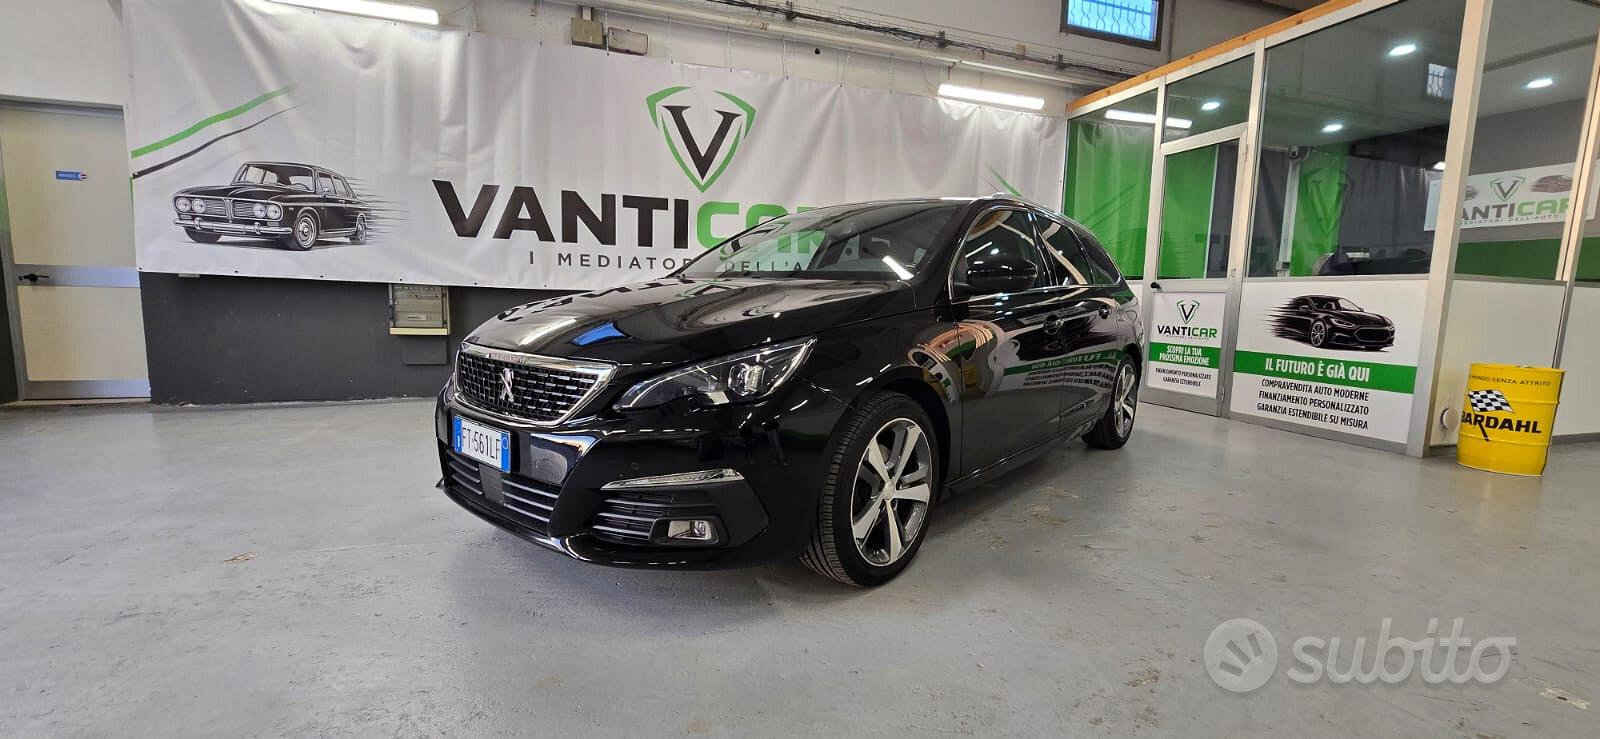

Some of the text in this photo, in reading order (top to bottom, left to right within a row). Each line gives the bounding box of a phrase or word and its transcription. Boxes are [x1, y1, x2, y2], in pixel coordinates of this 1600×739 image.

[662, 105, 743, 183] V
[1462, 197, 1570, 221] NTICA
[529, 250, 534, 265] I
[1157, 324, 1218, 339] VANTICAR
[1159, 352, 1210, 366] PROSSIMA EMOZIONE
[1167, 345, 1202, 356] SCOPRI LA TUA
[1265, 357, 1371, 382] IL FUTURO È GIÀ QUI
[1491, 377, 1517, 385] SENZA
[1261, 378, 1369, 401] COMPRAVENDITA AUTO MODERNE
[1258, 390, 1370, 416] FINANZIAMENTO PERSONALIZZATO
[1256, 402, 1369, 430] GARANZIA ESTENDIBILE SU MISURA
[1461, 410, 1542, 435] BARDAHL
